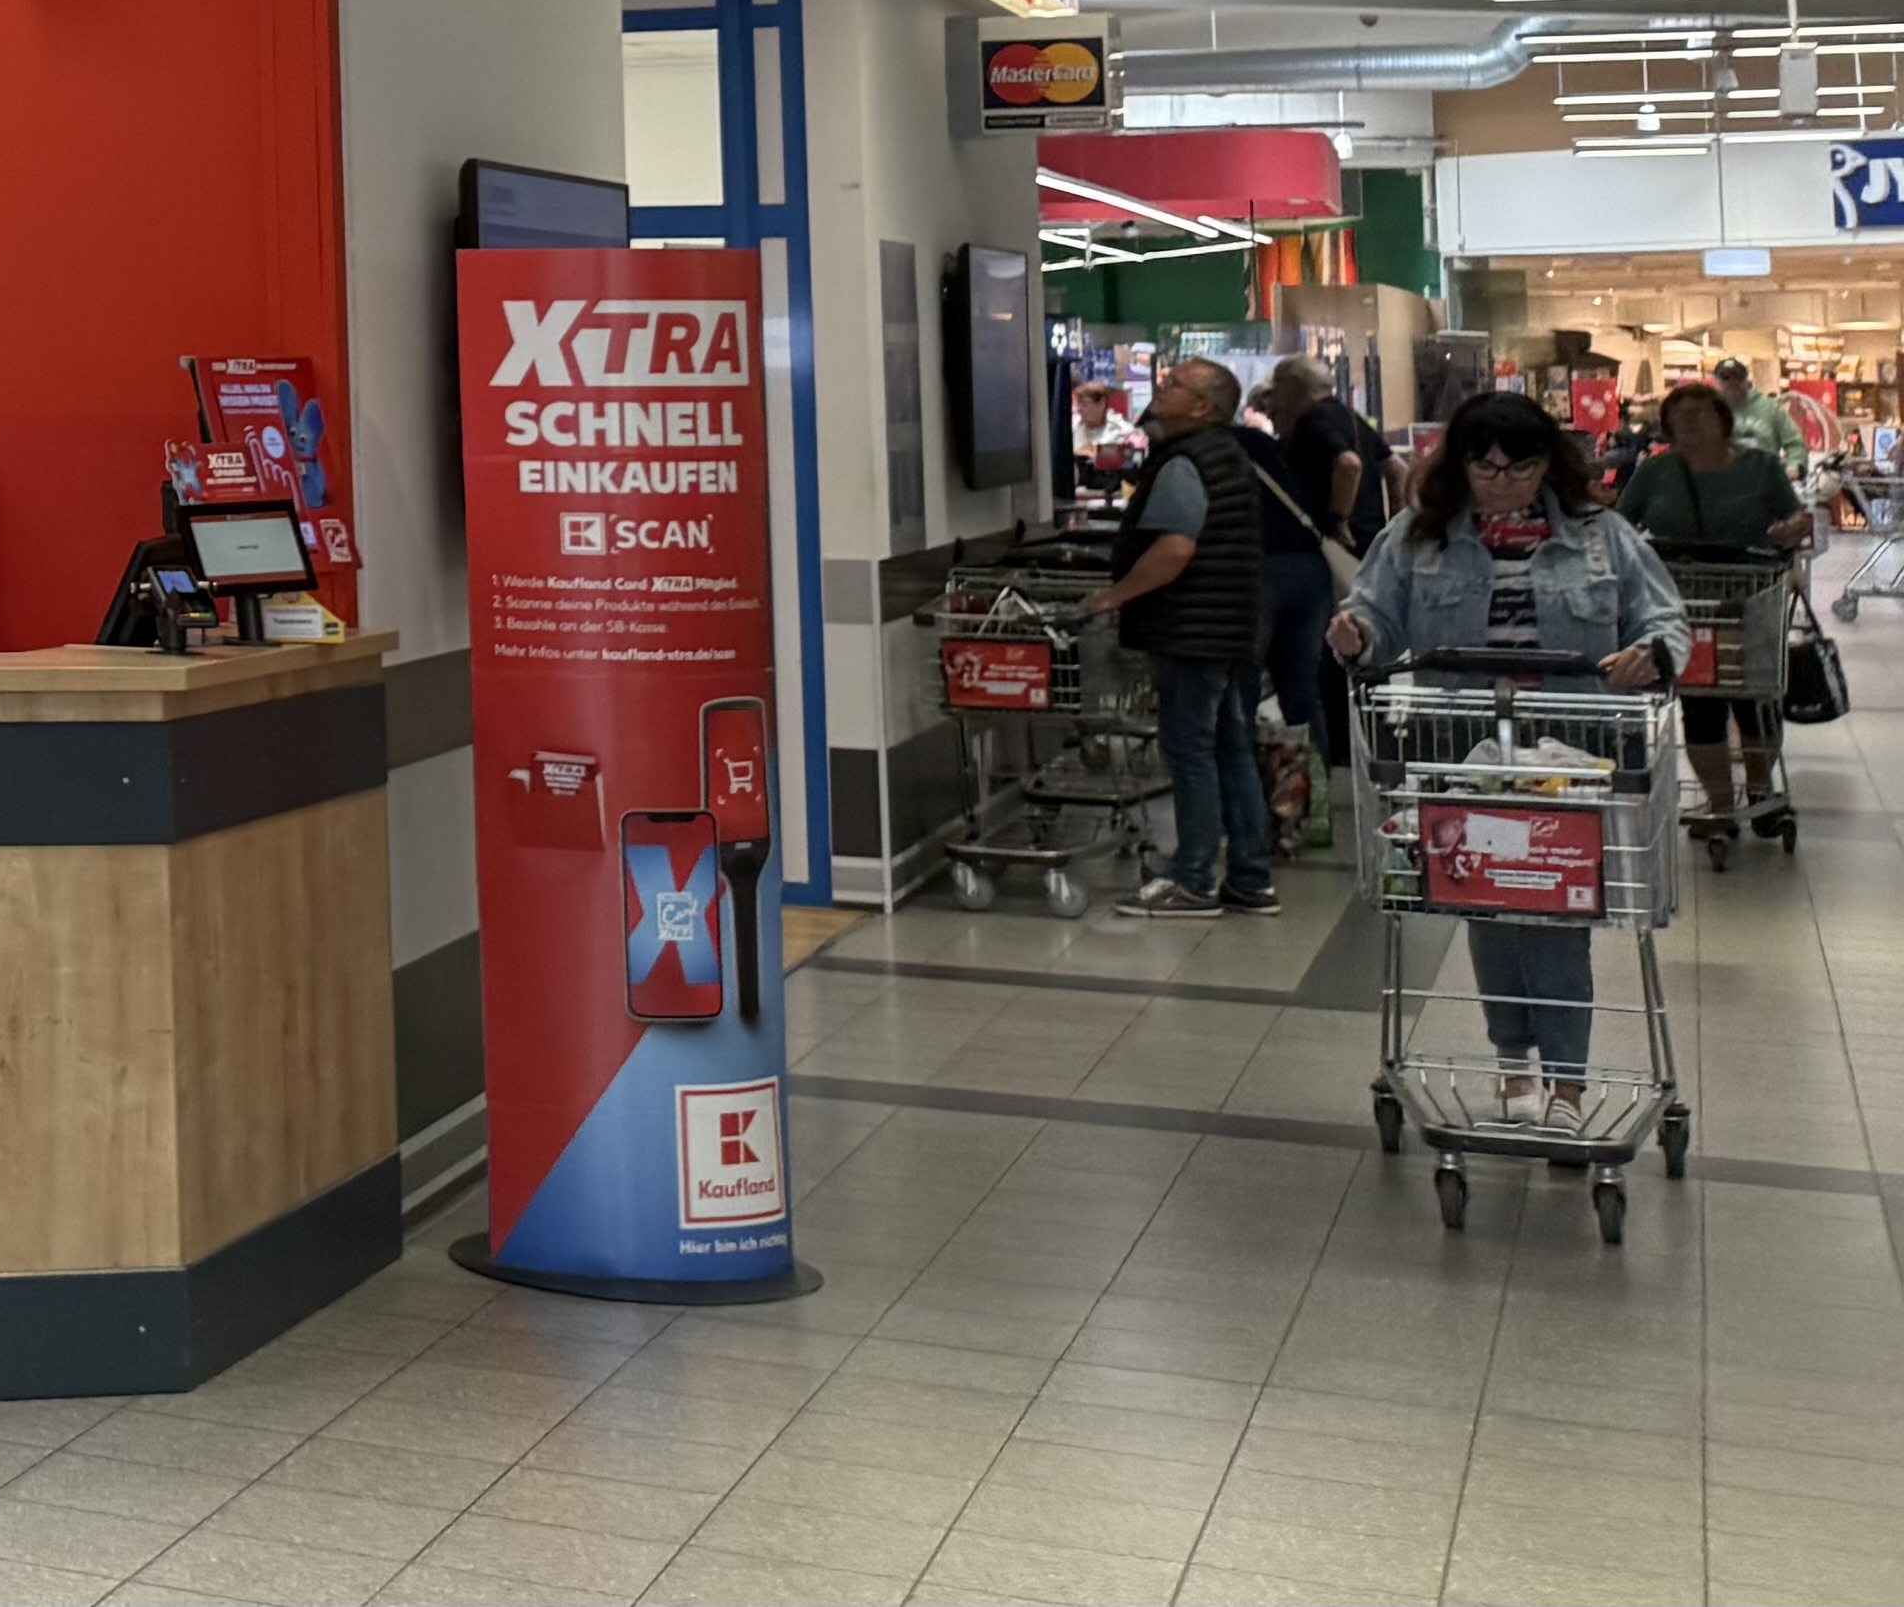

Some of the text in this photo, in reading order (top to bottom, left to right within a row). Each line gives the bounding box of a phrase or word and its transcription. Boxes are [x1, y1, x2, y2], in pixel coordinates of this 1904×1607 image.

[991, 65, 1095, 83] MasterCard
[489, 299, 749, 387] XTRA
[505, 401, 743, 447] SCHNELL
[519, 460, 737, 494] EINKAUFEN
[615, 519, 710, 549] SCAN
[547, 576, 611, 591] Kaufland
[615, 577, 647, 591] Card
[505, 597, 552, 610] Scanne
[555, 598, 593, 611] deine
[595, 598, 655, 612] Produkte
[506, 617, 556, 631] Bezahle
[495, 643, 526, 657] Mehr
[698, 1173, 775, 1200] Kaufland
